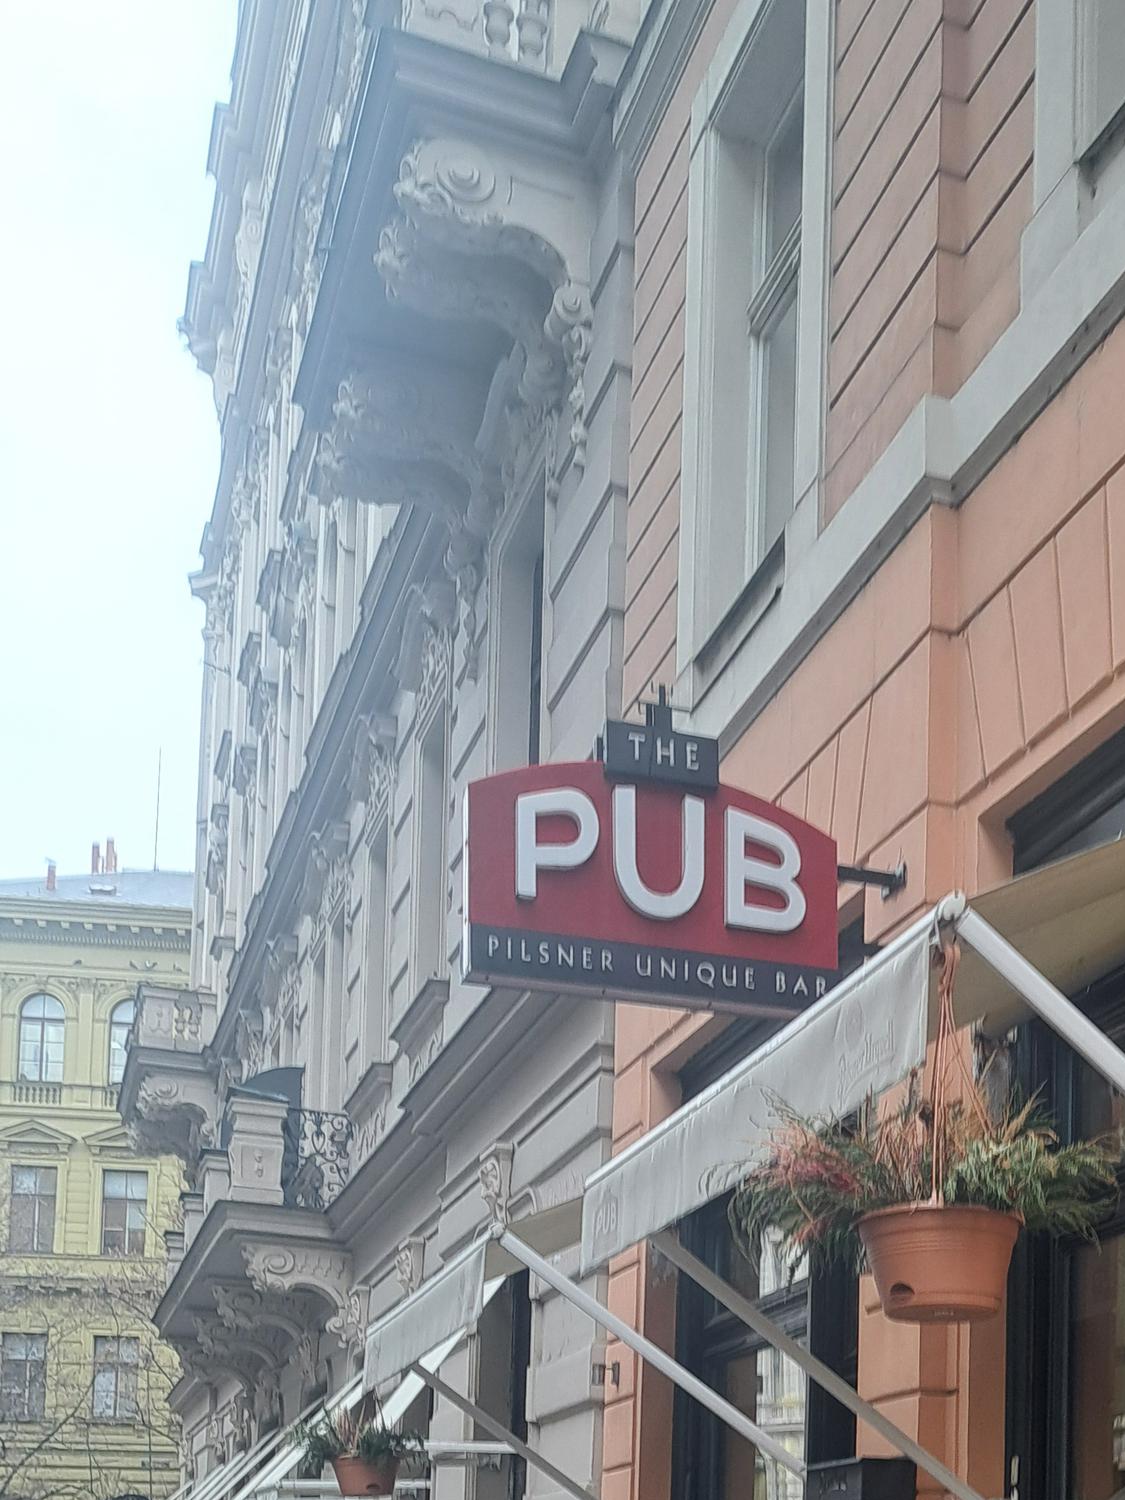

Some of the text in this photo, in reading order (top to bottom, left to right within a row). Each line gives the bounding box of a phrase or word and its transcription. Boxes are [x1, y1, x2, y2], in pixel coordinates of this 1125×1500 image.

[627, 732, 700, 770] THE
[515, 784, 807, 933] PUB
[487, 935, 827, 996] PILSNER UNIQUE BAR
